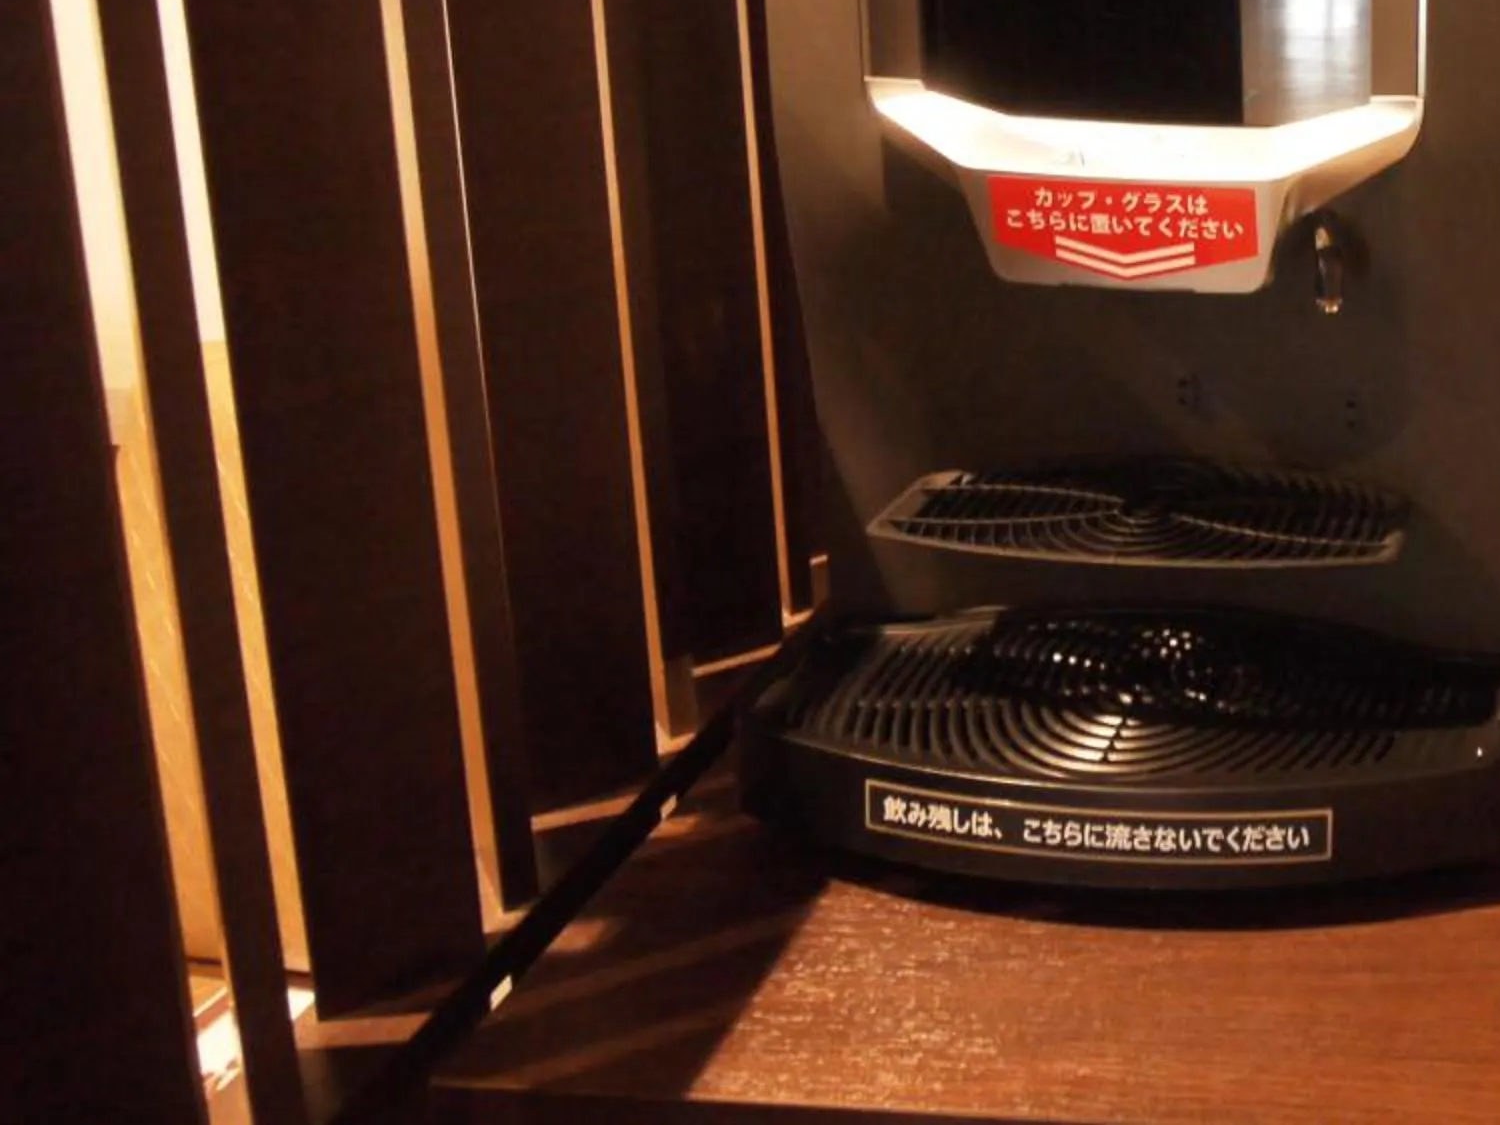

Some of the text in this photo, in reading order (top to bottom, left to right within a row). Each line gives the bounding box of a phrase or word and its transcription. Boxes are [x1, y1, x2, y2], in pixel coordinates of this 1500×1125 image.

[1035, 186, 1209, 214] カップ・グラスは
[1007, 209, 1244, 240] こちらに置いてください
